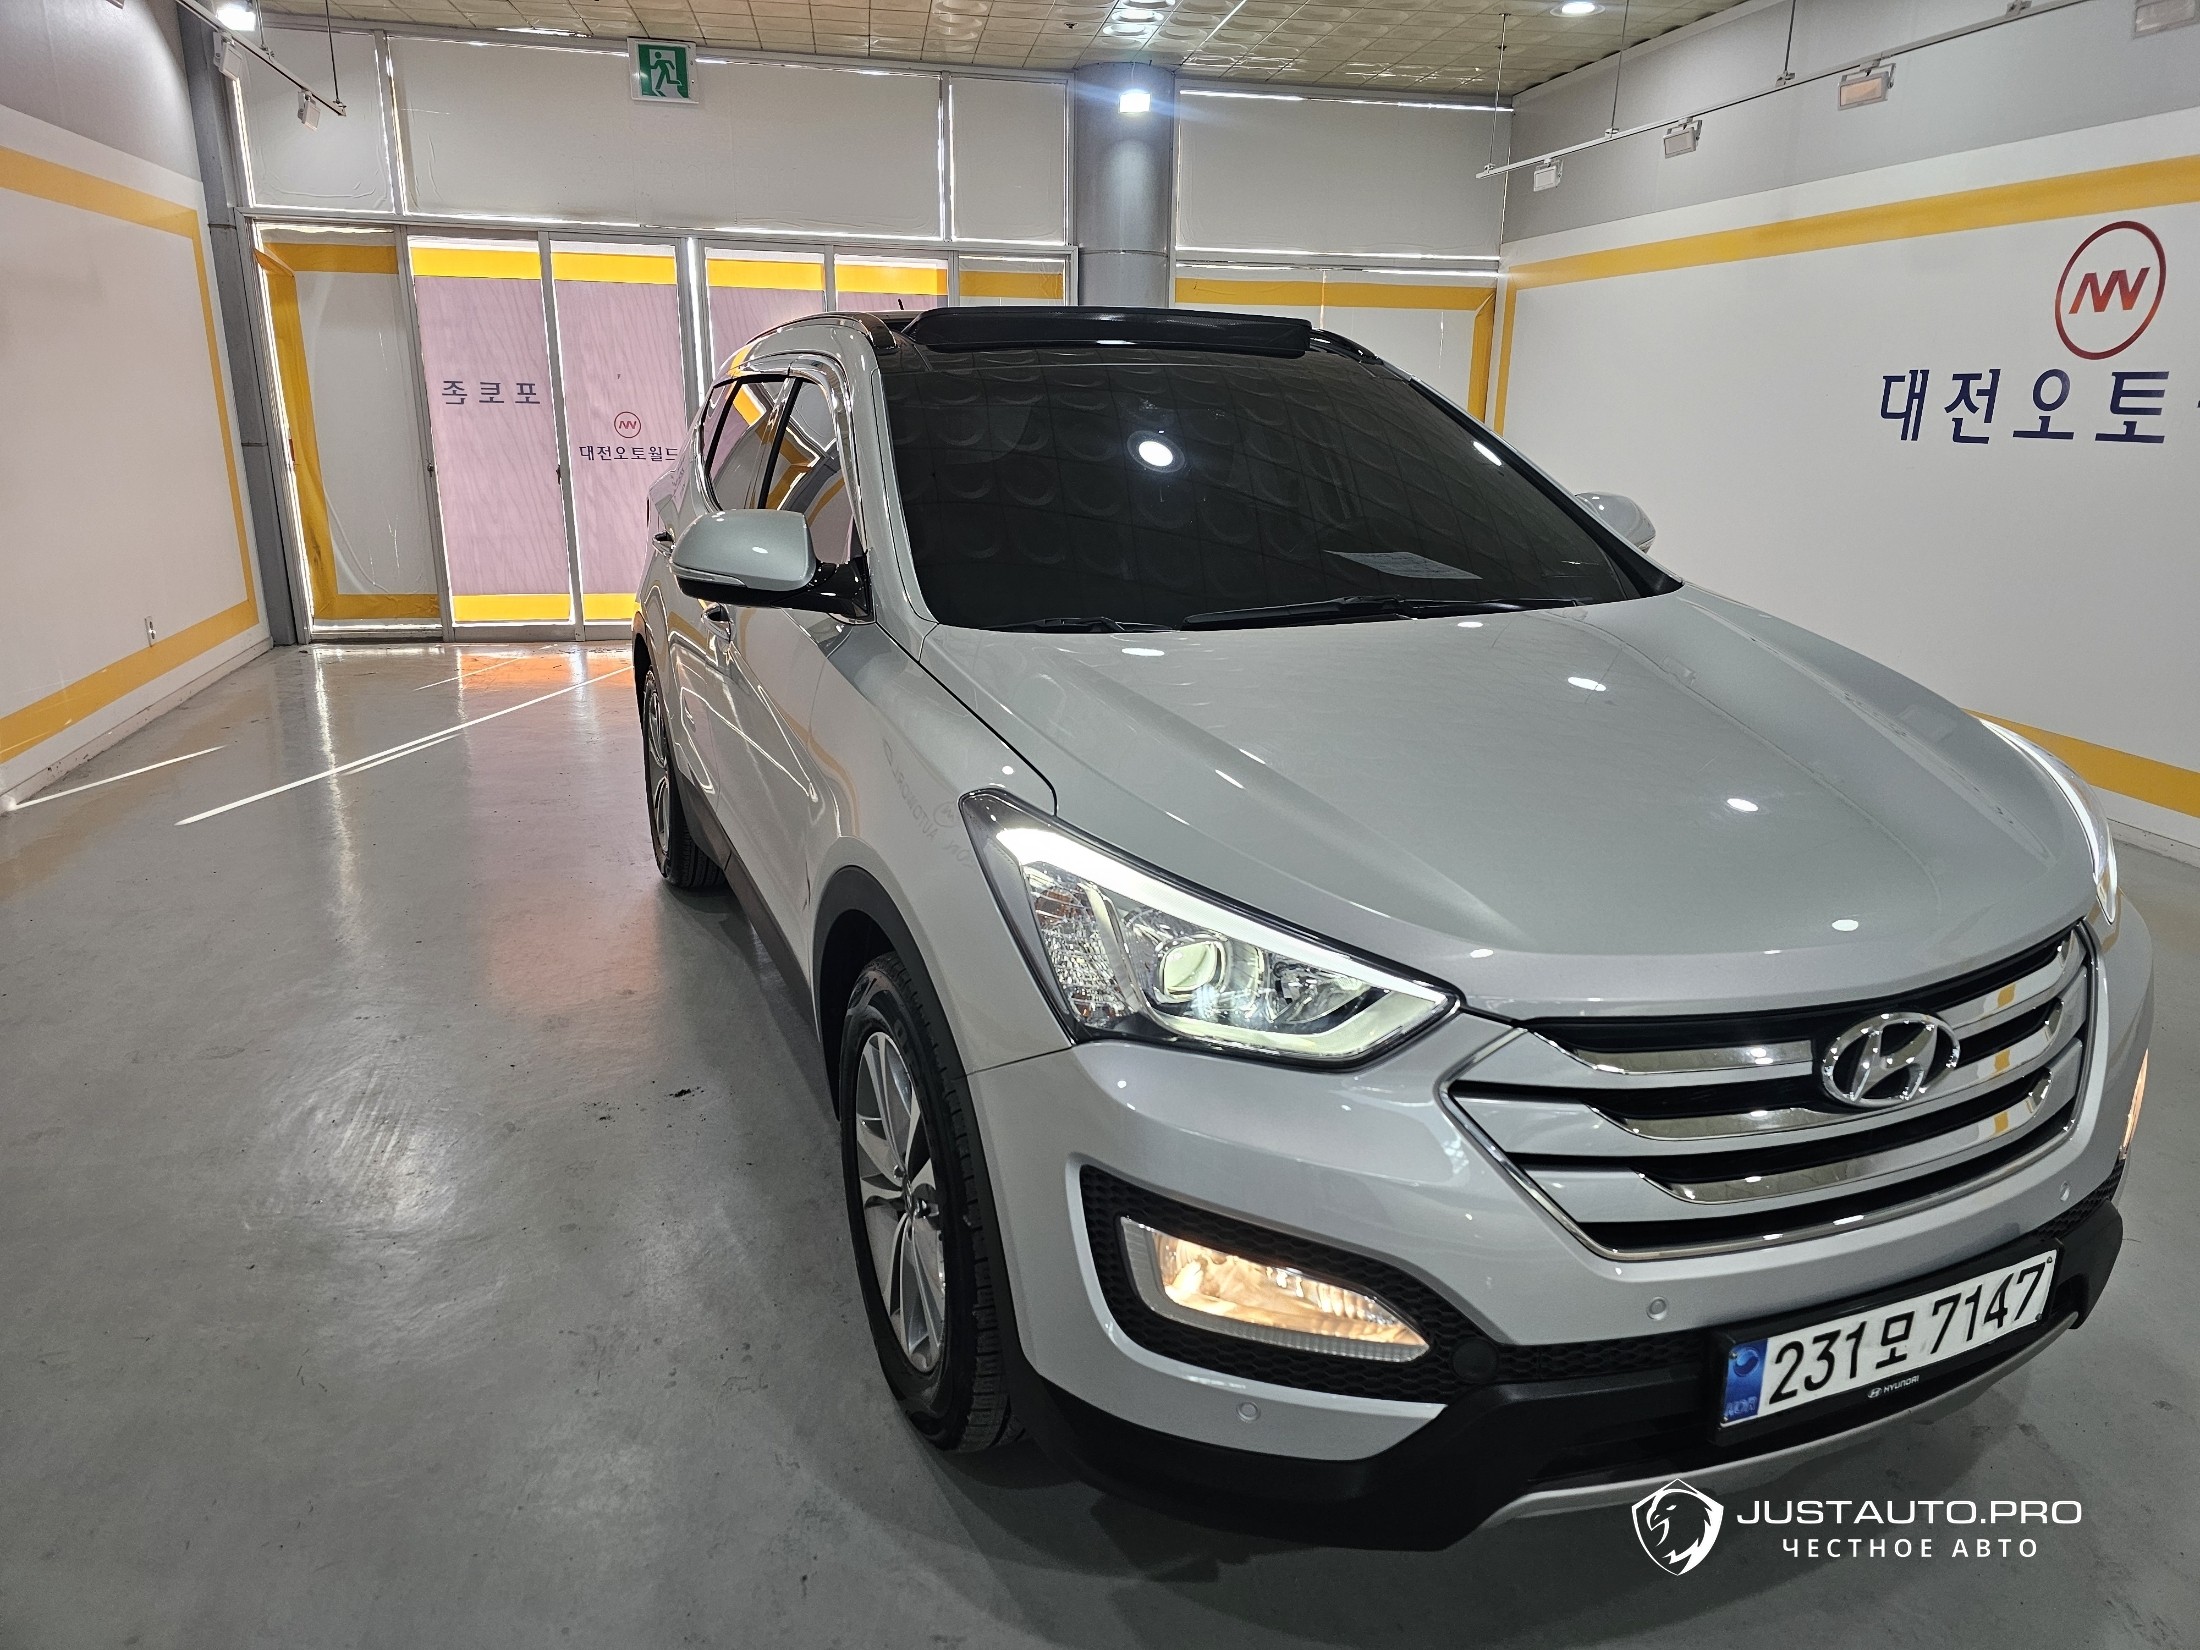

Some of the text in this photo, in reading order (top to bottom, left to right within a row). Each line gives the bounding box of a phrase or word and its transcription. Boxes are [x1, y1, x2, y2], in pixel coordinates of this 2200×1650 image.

[1880, 367, 2200, 445] 대전오토
[578, 445, 679, 462] 대전오토월드
[1768, 1261, 2047, 1406] 231모 7147
[1883, 1374, 1920, 1394] HYUNDAI
